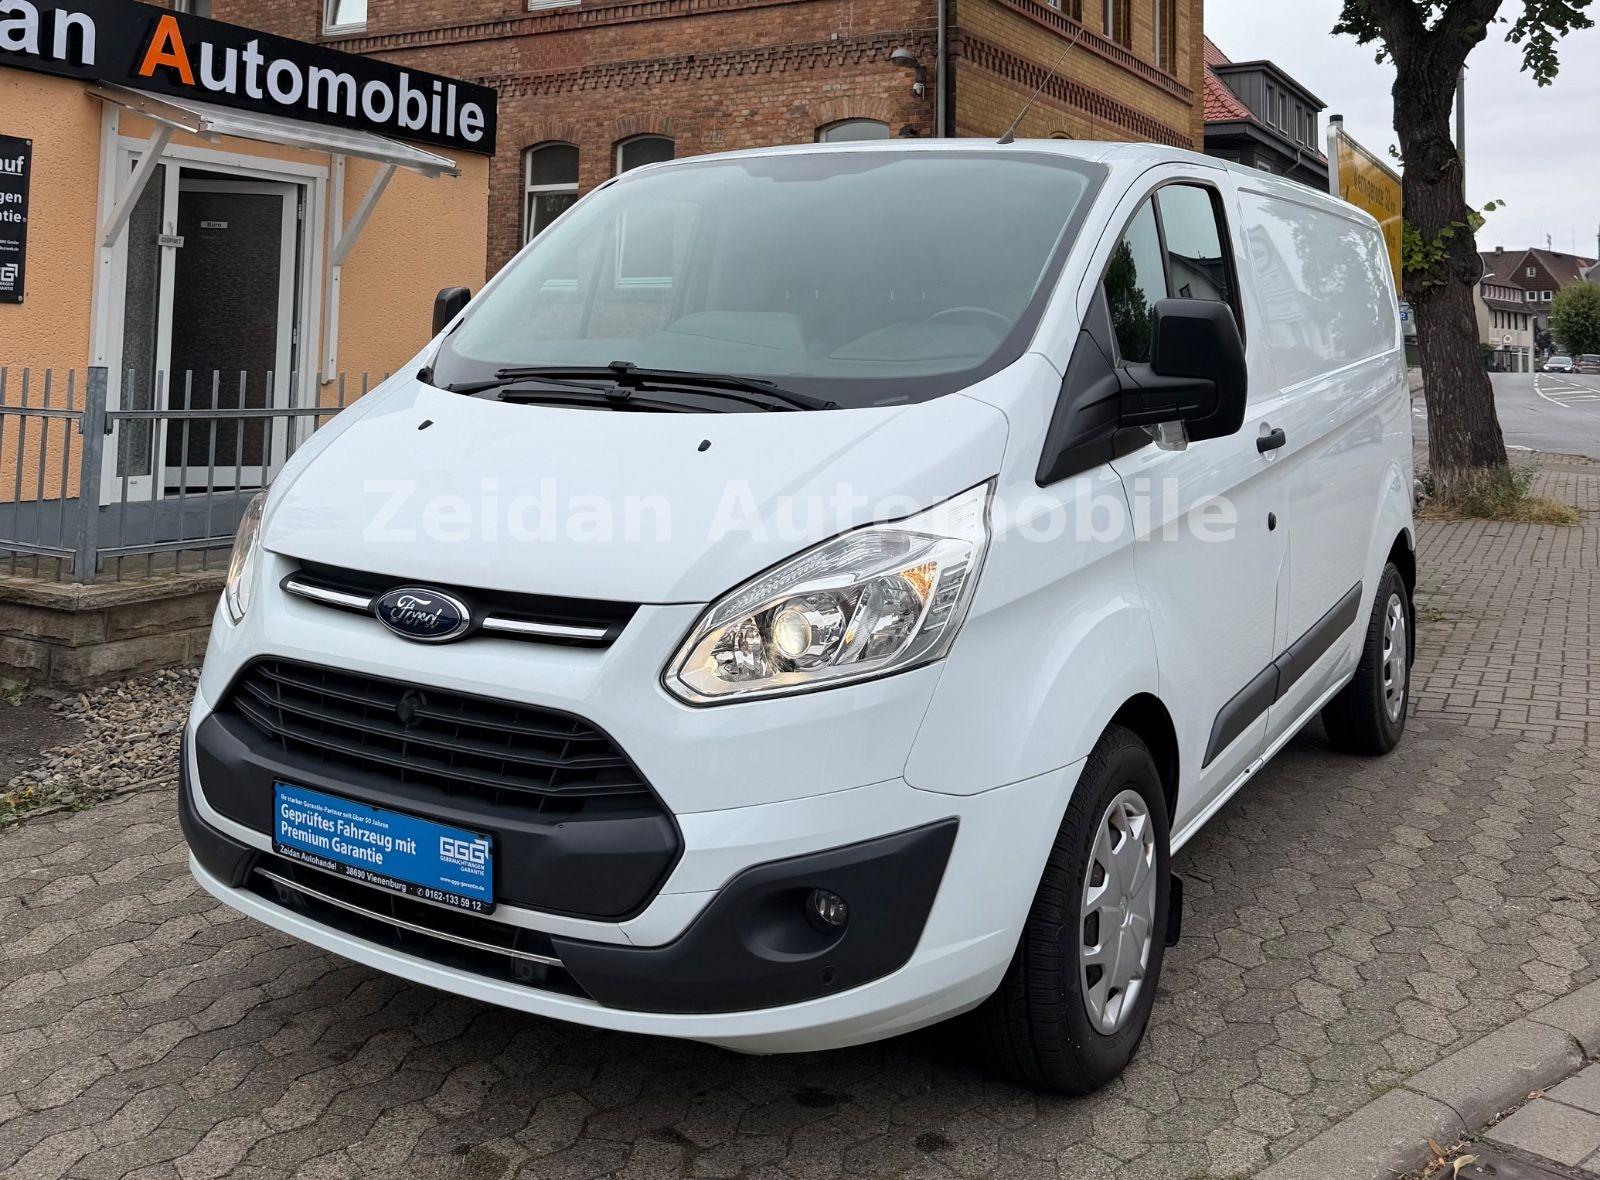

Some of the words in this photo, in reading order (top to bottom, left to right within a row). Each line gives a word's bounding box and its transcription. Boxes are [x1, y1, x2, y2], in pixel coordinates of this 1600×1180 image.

[139, 14, 485, 143] Automobile
[390, 595, 443, 629] Ford
[281, 803, 335, 832] Geprüftes
[337, 820, 392, 852] Fahrzeug
[395, 837, 417, 855] mit
[281, 820, 330, 850] Premium
[332, 837, 383, 864] Garantie
[280, 844, 301, 859] Zeidan
[301, 852, 337, 870] Autohandel
[345, 866, 366, 879] 38690
[366, 872, 407, 893] Vienenburg
[425, 888, 459, 905] 0162-133
[460, 896, 470, 908] 59
[472, 898, 482, 911] 12
